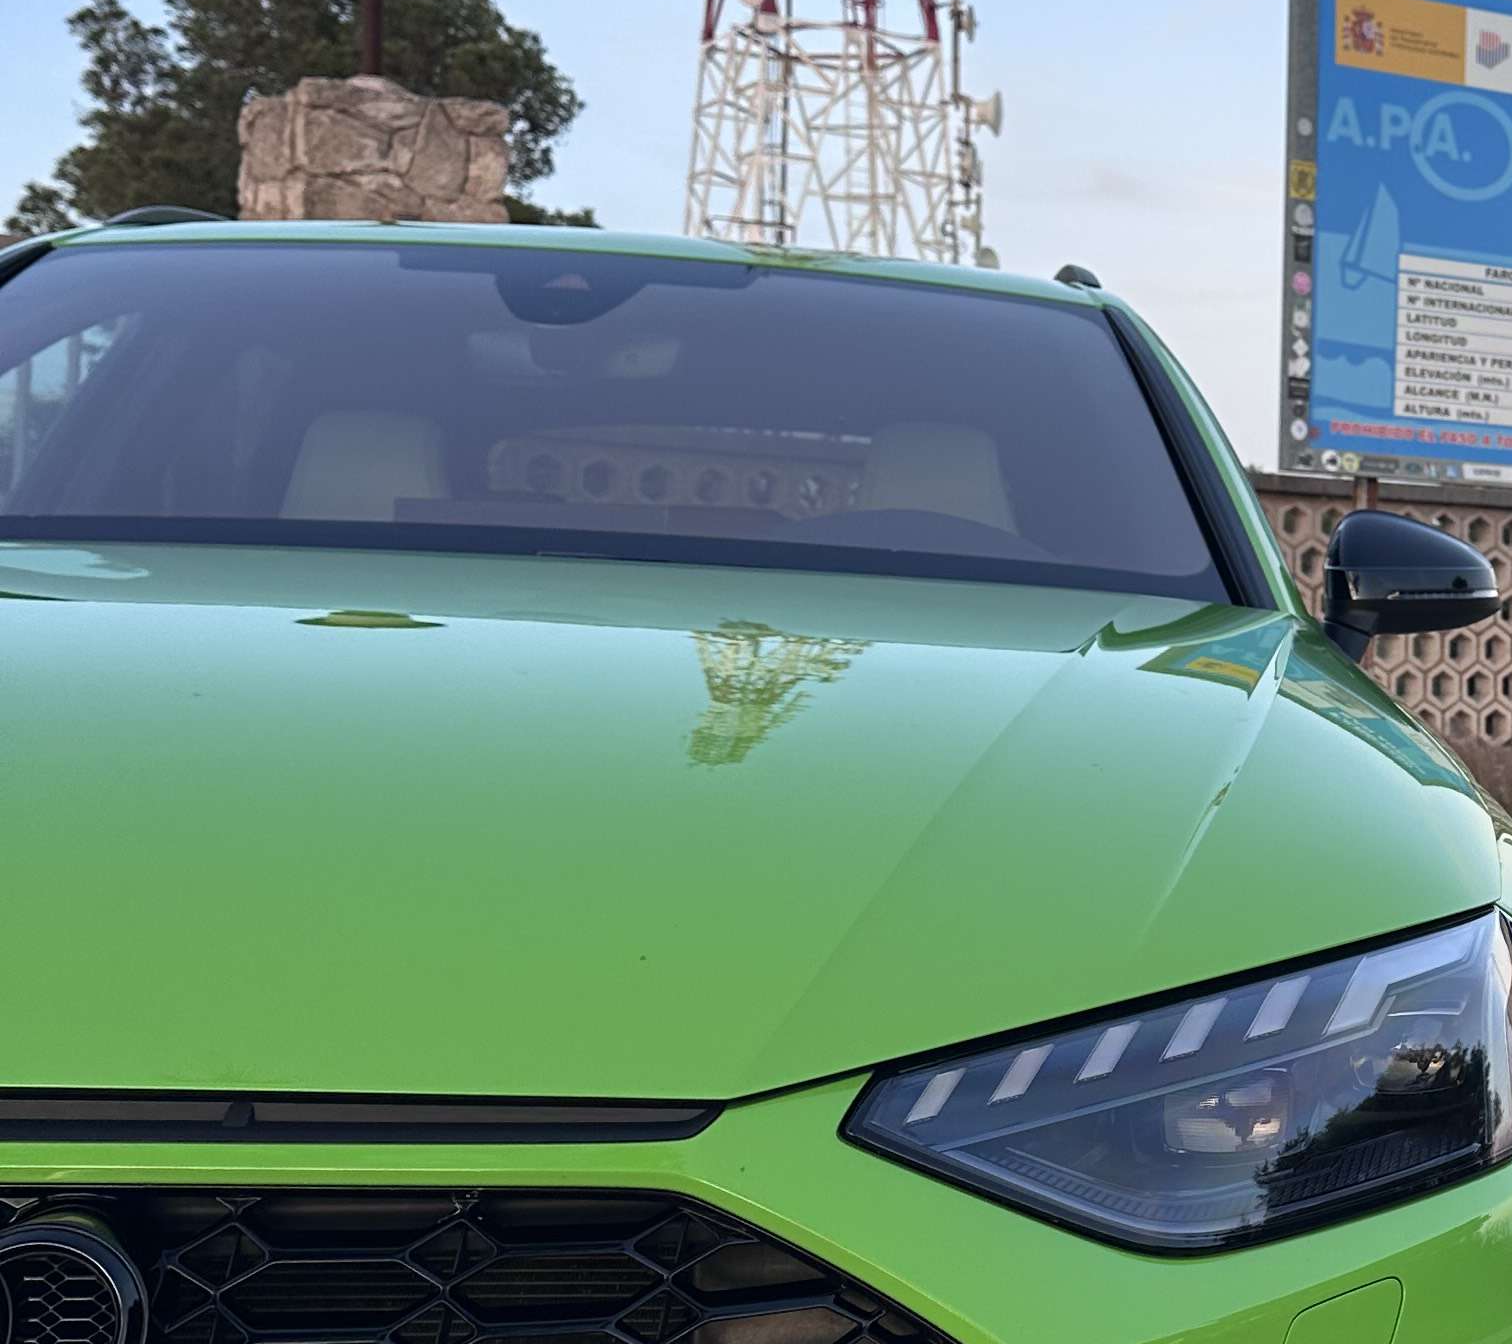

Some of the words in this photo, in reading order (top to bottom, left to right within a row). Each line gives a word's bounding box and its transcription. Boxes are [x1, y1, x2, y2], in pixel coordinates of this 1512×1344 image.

[1424, 280, 1485, 296] NACIONAL
[1406, 312, 1458, 328] LATITUD
[1405, 331, 1468, 347] LONGITUD
[1405, 349, 1476, 366] APARIENCIA
[1480, 357, 1488, 367] Y
[1404, 385, 1459, 400] ALCANCE
[1404, 404, 1451, 417] ALTURA
[1330, 420, 1414, 441] PROHIBIDO
[1440, 430, 1477, 445] PASO
